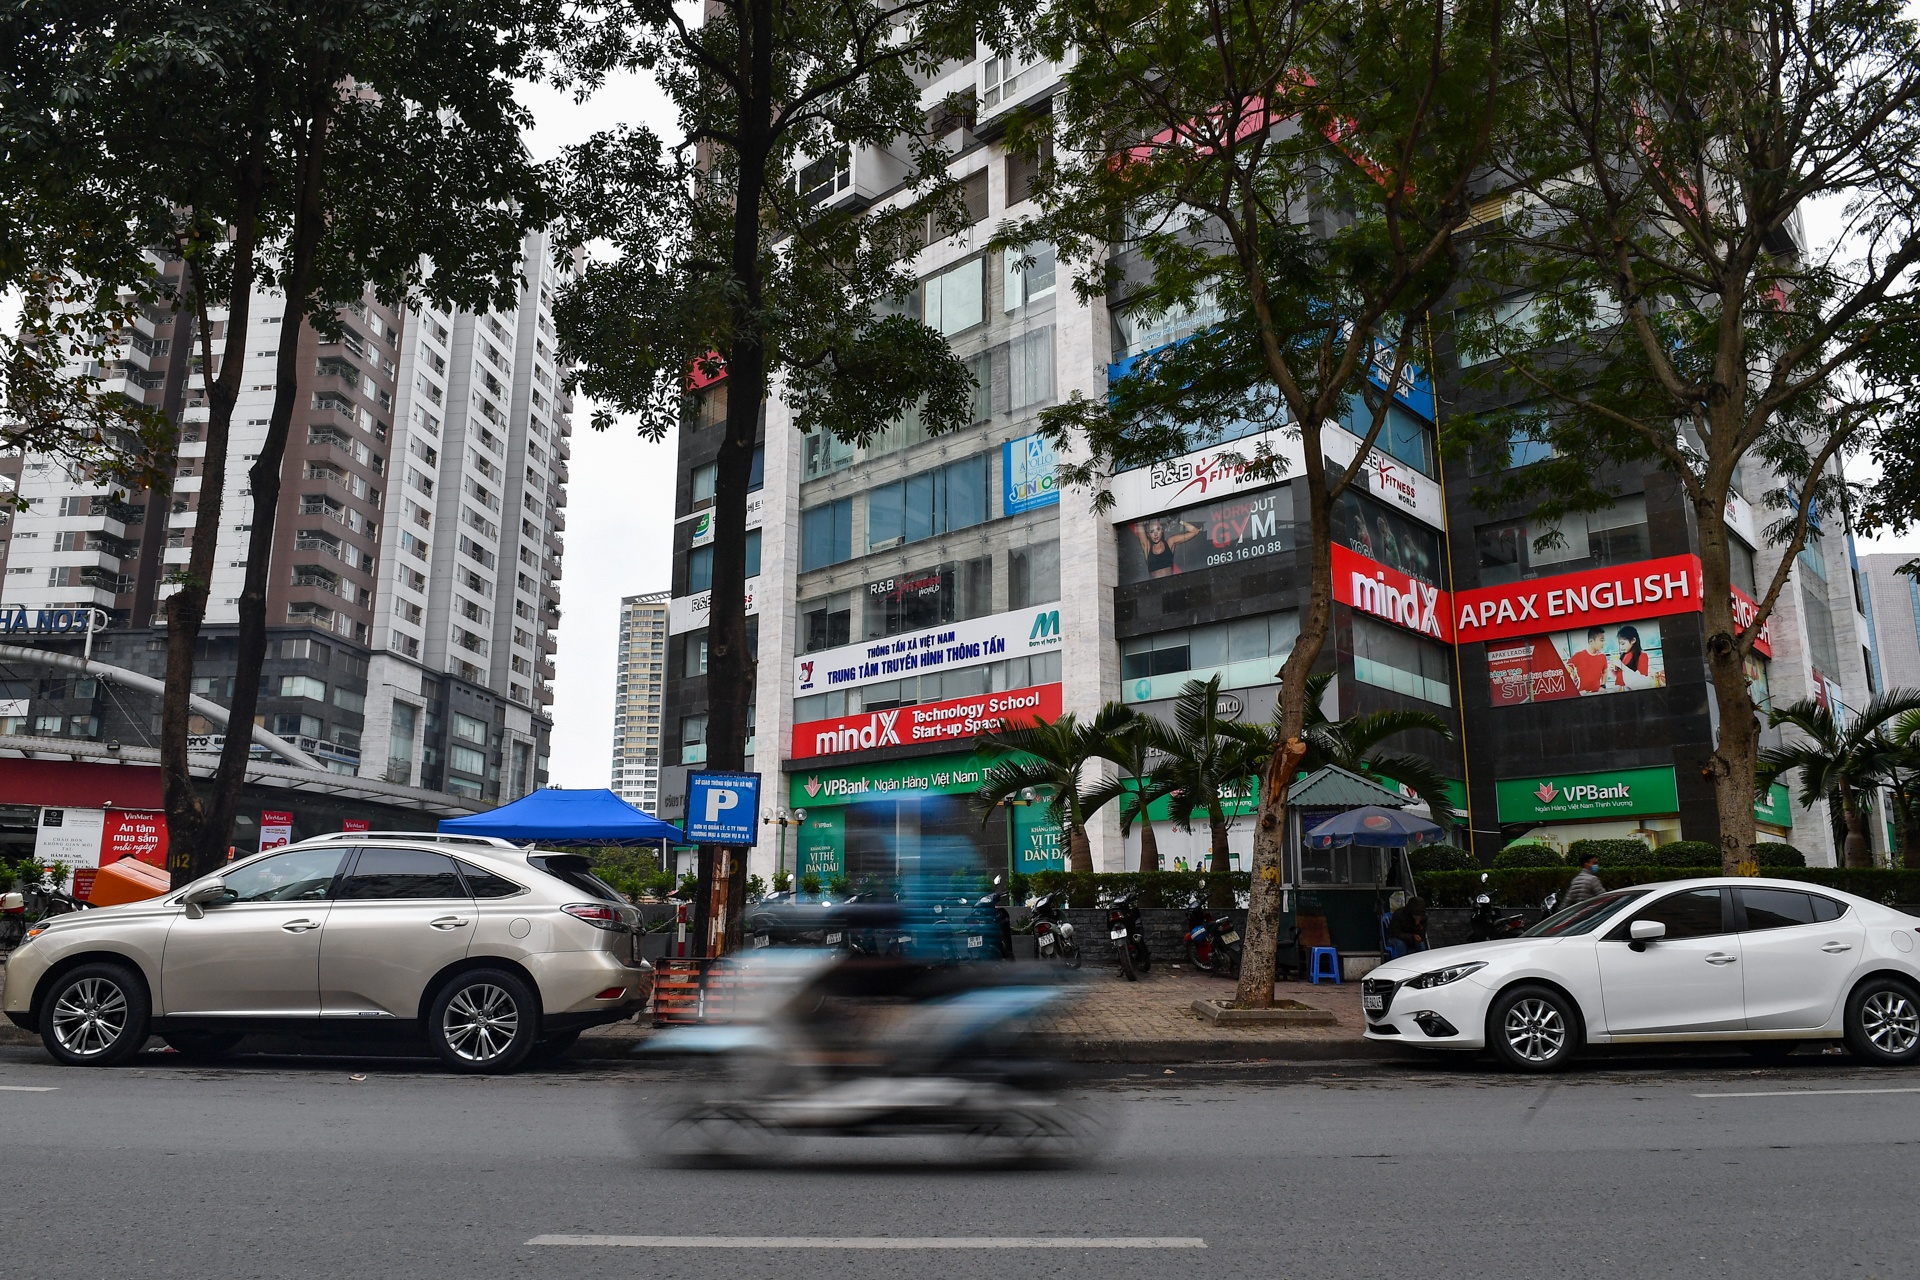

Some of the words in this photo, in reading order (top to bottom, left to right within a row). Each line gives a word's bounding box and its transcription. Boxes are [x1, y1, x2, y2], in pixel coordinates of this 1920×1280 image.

[1020, 453, 1053, 472] APOLLO
[1355, 442, 1379, 470] &B
[1385, 474, 1416, 498] FITNESS
[1151, 463, 1193, 489] R&B
[1209, 460, 1264, 482] FITN
[1235, 468, 1270, 485] WORL
[1010, 475, 1054, 501] JUNIO
[1211, 496, 1276, 522] WORKOUT
[1397, 492, 1417, 509] WORLD
[1211, 510, 1277, 548] GYM
[1206, 551, 1234, 566] 0963
[1236, 548, 1249, 560] 16
[1251, 544, 1265, 556] 00
[1267, 541, 1282, 553] 88
[1350, 538, 1375, 560] YOGA
[870, 579, 894, 595] R&B
[901, 575, 941, 593] FITNESS
[918, 584, 940, 597] WORLD
[1351, 570, 1442, 639] mindX
[1458, 594, 1539, 630] APAX
[1547, 570, 1690, 616] ENGLISH
[867, 644, 890, 659] THÔNG
[892, 640, 906, 655] TẤN
[907, 639, 918, 653] XÃ
[920, 635, 936, 651] VIỆT
[937, 630, 955, 645] NAM
[1491, 651, 1507, 659] APAX
[1507, 647, 1533, 657] LEADERS
[827, 667, 857, 685] TRUNG
[858, 662, 879, 679] TÂM
[881, 652, 918, 675] TRUYỀN
[920, 649, 944, 668] HÌNH
[946, 640, 980, 662] THÔNG
[983, 635, 1005, 657] TẤN
[800, 682, 814, 691] NEWS
[1501, 675, 1566, 699] STEAM
[912, 703, 985, 725] Technology
[988, 691, 1040, 713] School
[815, 709, 900, 755] mindX
[911, 720, 962, 740] Start-up
[823, 776, 869, 797] VPBank
[874, 779, 900, 794] Ngân
[902, 776, 928, 792] Hàng
[930, 772, 950, 787] Việt
[952, 769, 979, 785] Nam
[1563, 782, 1630, 802] VPBank
[705, 788, 739, 822] P
[1534, 805, 1550, 813] Ngân
[1551, 804, 1567, 812] Hàng
[1567, 803, 1579, 811] Việt
[1579, 801, 1594, 809] Nam
[1594, 801, 1611, 809] Thịnh
[1611, 799, 1633, 808] Vượng
[124, 812, 153, 821] VinMart
[264, 813, 287, 821] VinMart
[345, 821, 365, 829] VinMart
[113, 834, 135, 843] mua
[137, 832, 159, 843] sắm
[119, 823, 134, 833] An
[136, 823, 155, 833] tâm
[132, 843, 157, 855] ngày!
[1030, 834, 1043, 848] VỊ
[1044, 833, 1061, 845] TH
[172, 853, 190, 869] 112
[810, 852, 818, 864] VỊ
[819, 848, 835, 861] THẾ
[1024, 845, 1049, 861] DẪN
[805, 860, 822, 873] DẪN
